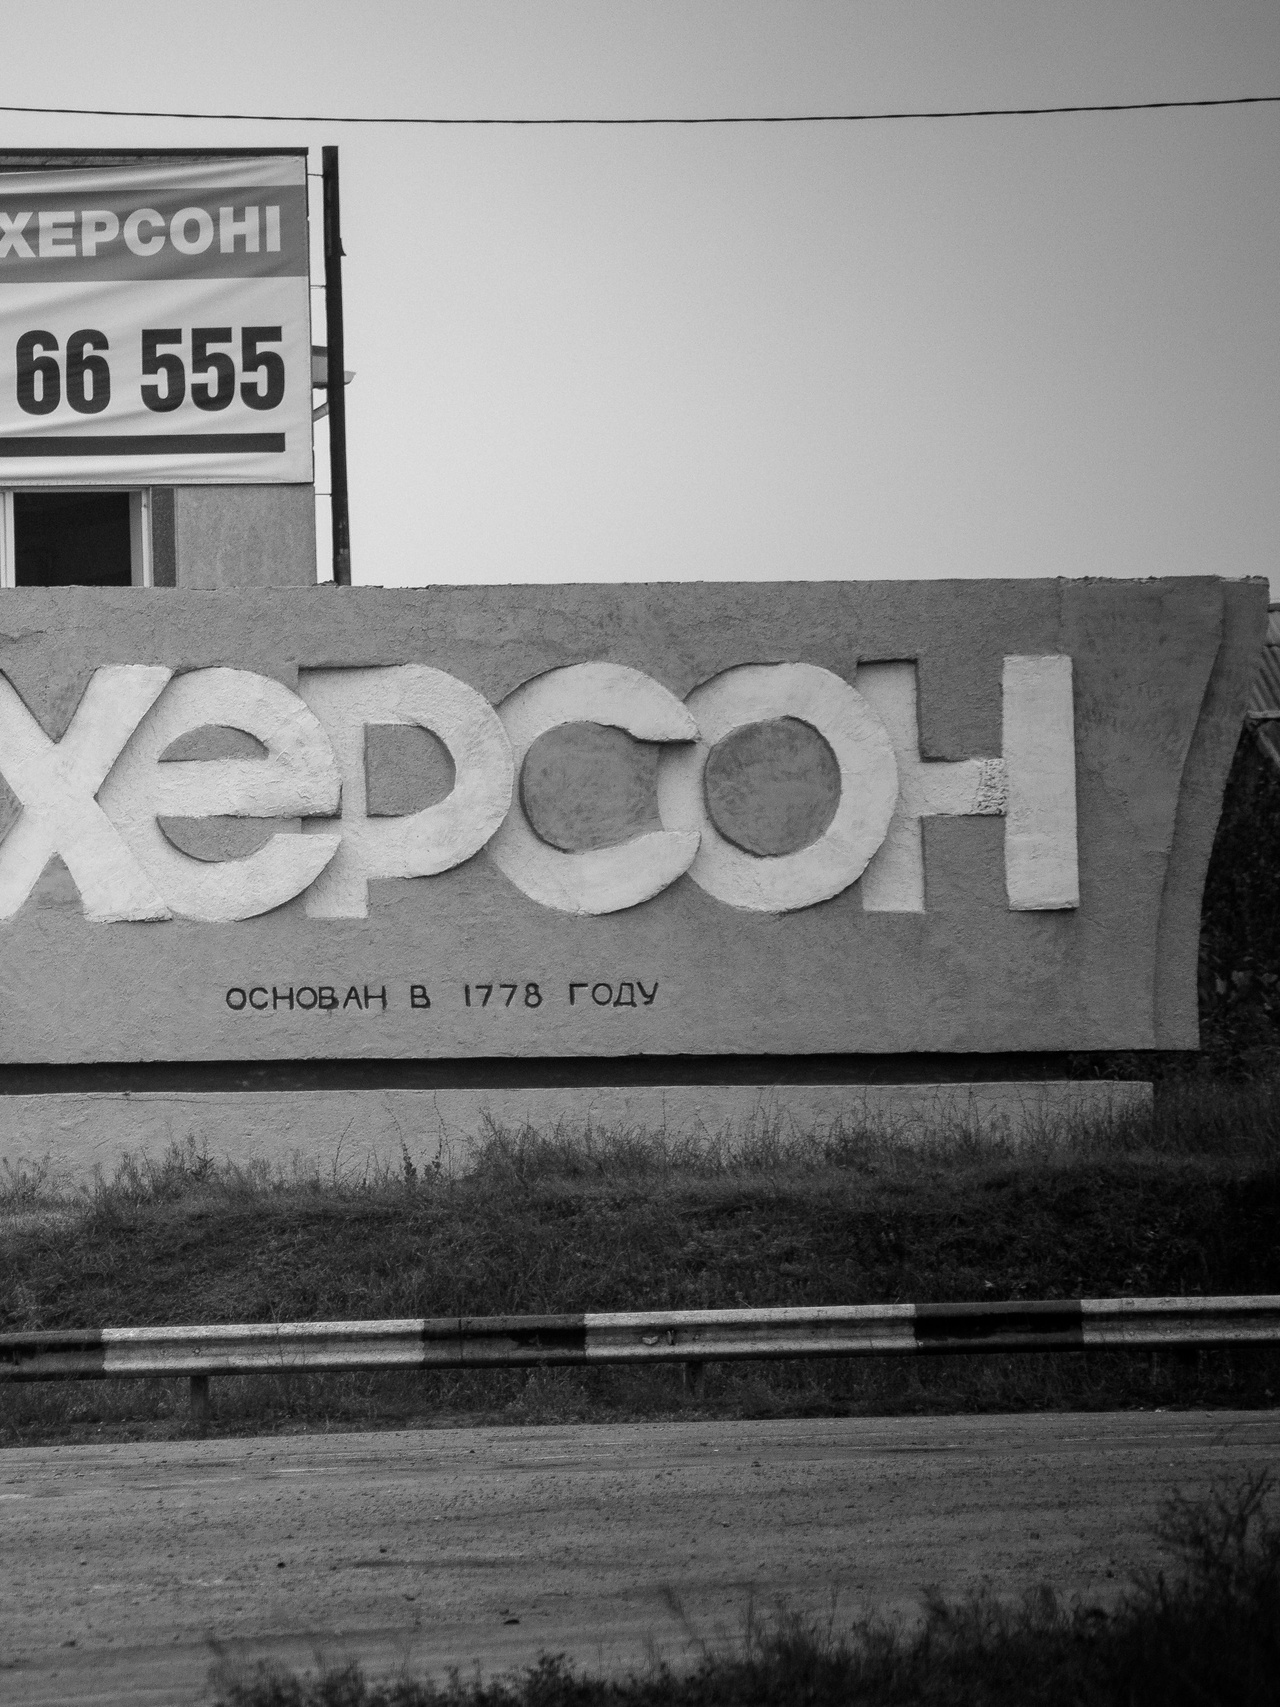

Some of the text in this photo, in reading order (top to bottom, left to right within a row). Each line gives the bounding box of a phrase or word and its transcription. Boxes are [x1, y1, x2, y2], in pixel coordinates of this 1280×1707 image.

[15, 329, 111, 415] 66
[140, 326, 286, 412] 555
[225, 981, 659, 1011] ОСНОВАН В 1778 ГОДУ
